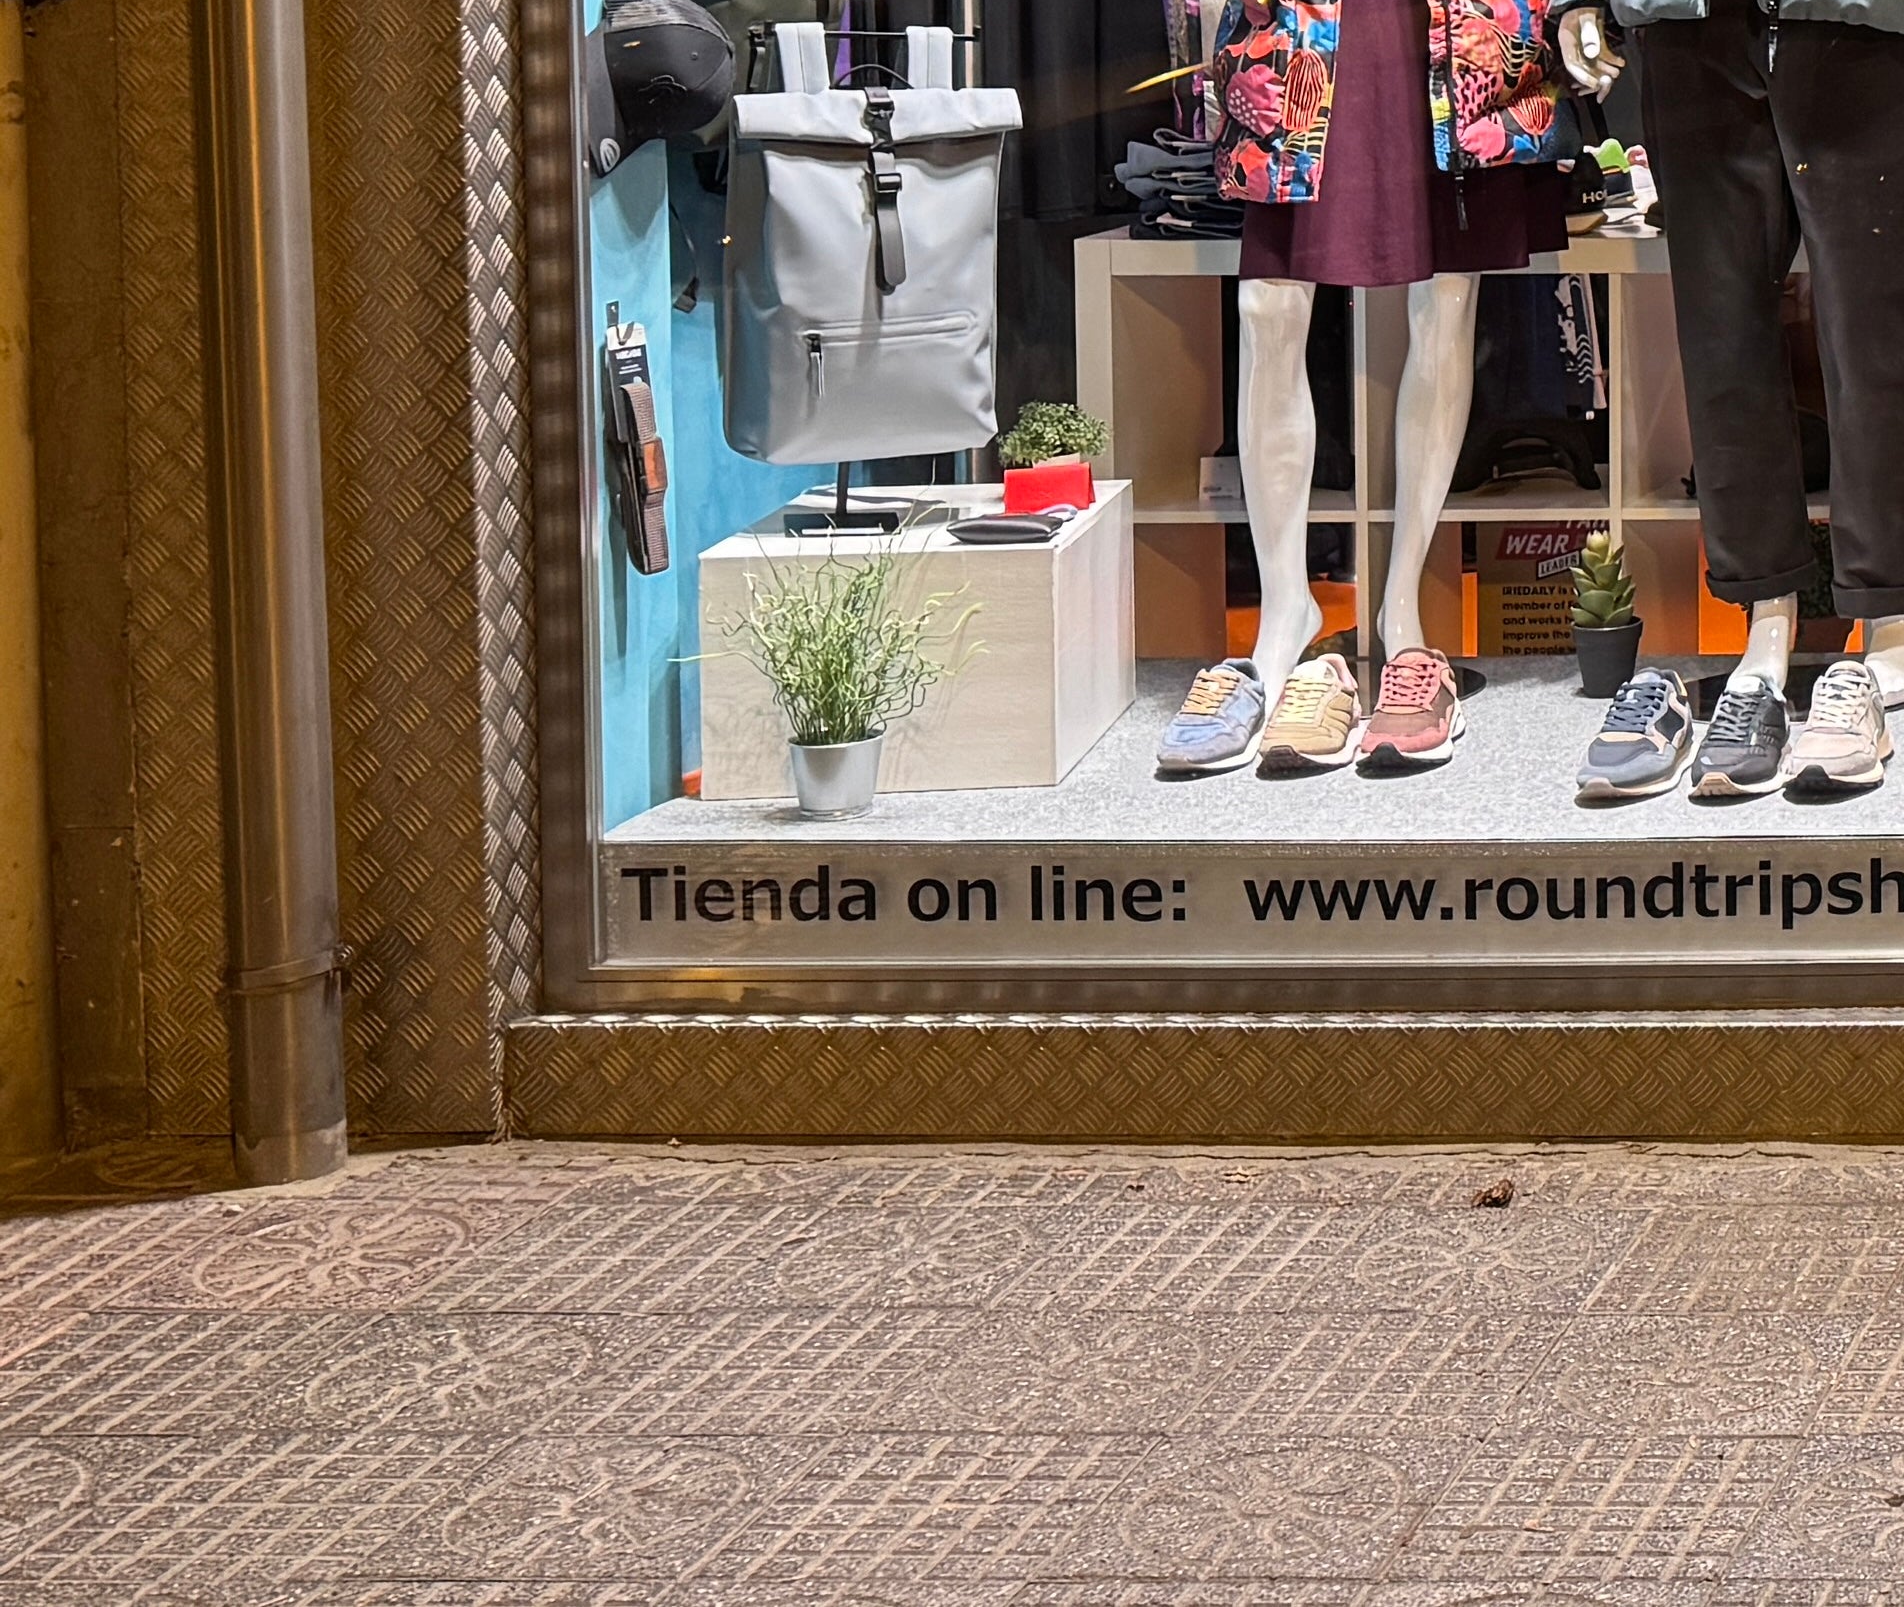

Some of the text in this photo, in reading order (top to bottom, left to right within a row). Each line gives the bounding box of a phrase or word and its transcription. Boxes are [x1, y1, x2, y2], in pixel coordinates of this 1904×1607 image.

[1505, 534, 1570, 555] WEAR
[1541, 554, 1578, 575] LEADER
[1502, 600, 1565, 610] member of
[1502, 615, 1562, 626] and works
[1502, 629, 1571, 643] improve the
[620, 865, 877, 923] Tienda
[906, 876, 998, 923] on
[1030, 864, 1188, 923] line:
